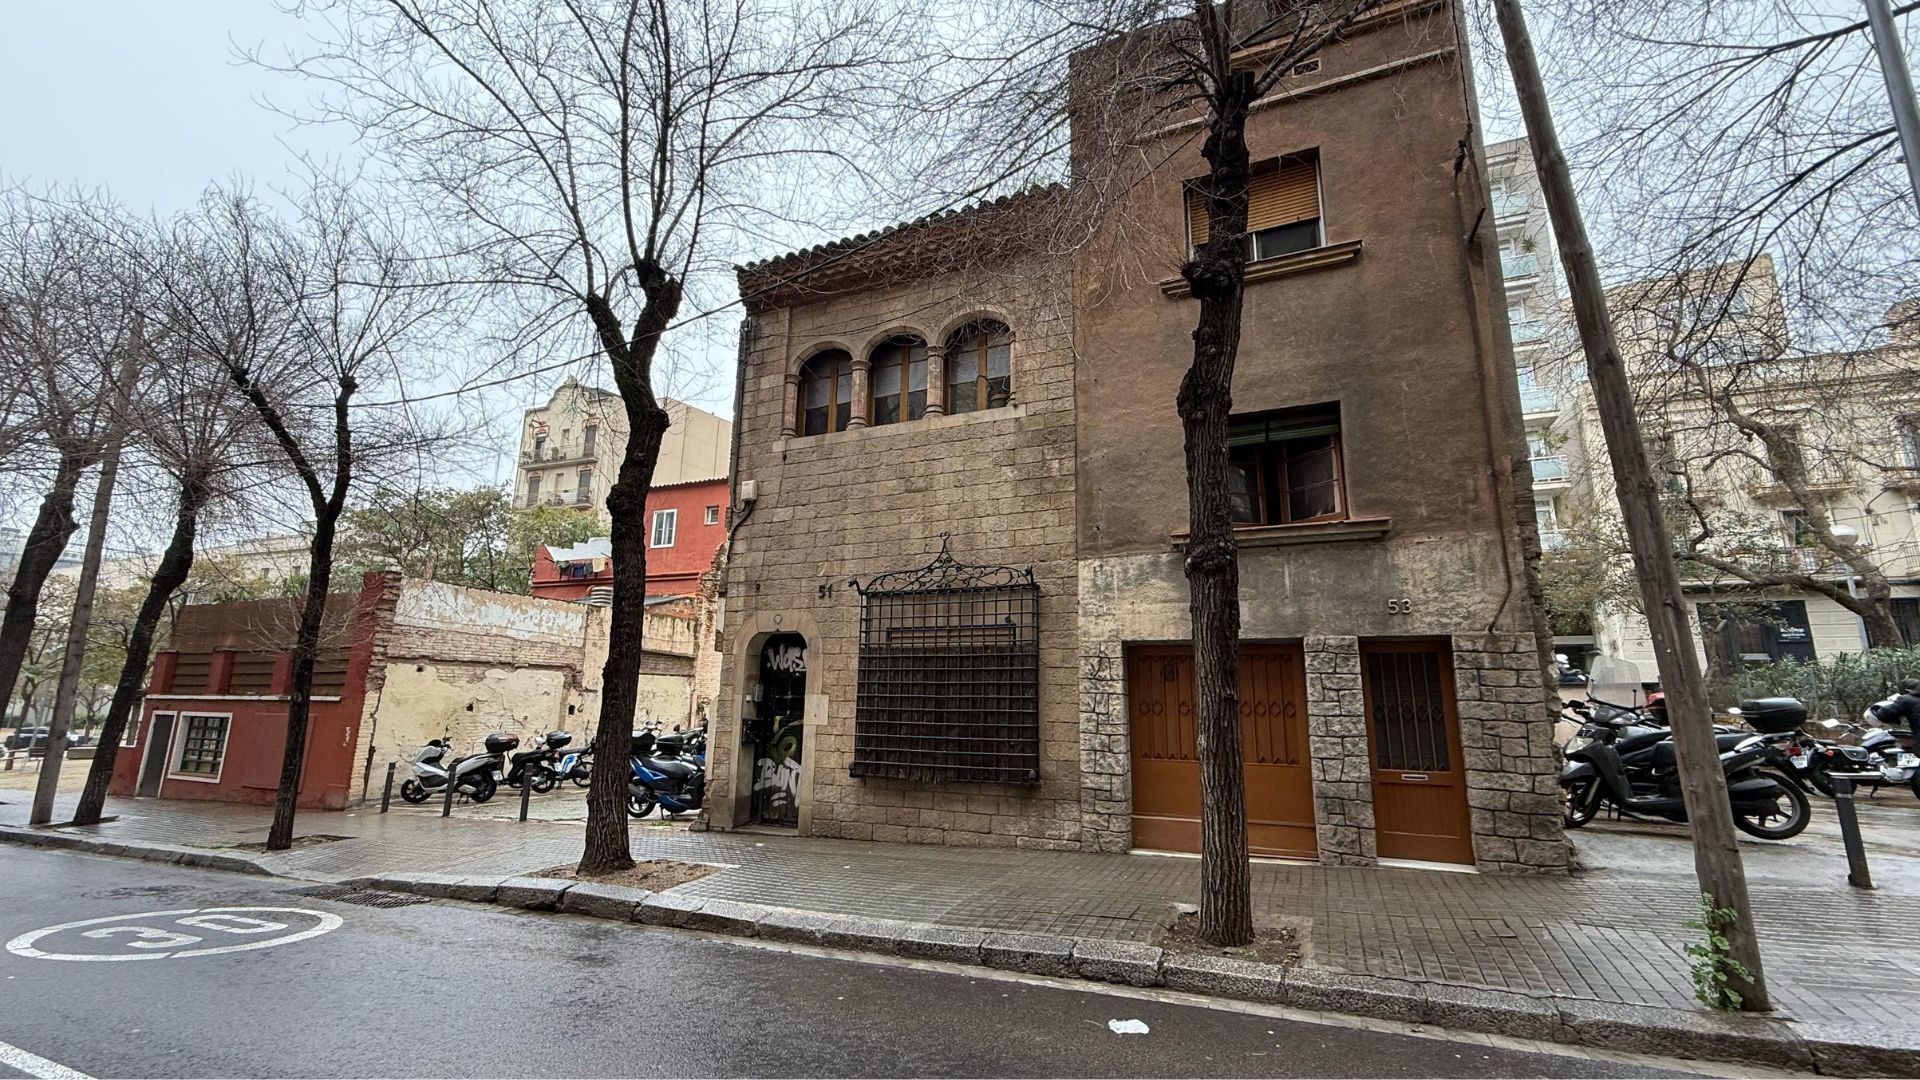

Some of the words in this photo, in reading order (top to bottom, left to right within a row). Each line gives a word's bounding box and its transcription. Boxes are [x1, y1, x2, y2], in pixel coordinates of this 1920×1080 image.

[818, 584, 833, 598] 51
[1388, 598, 1412, 614] 53
[81, 914, 289, 949] 30
